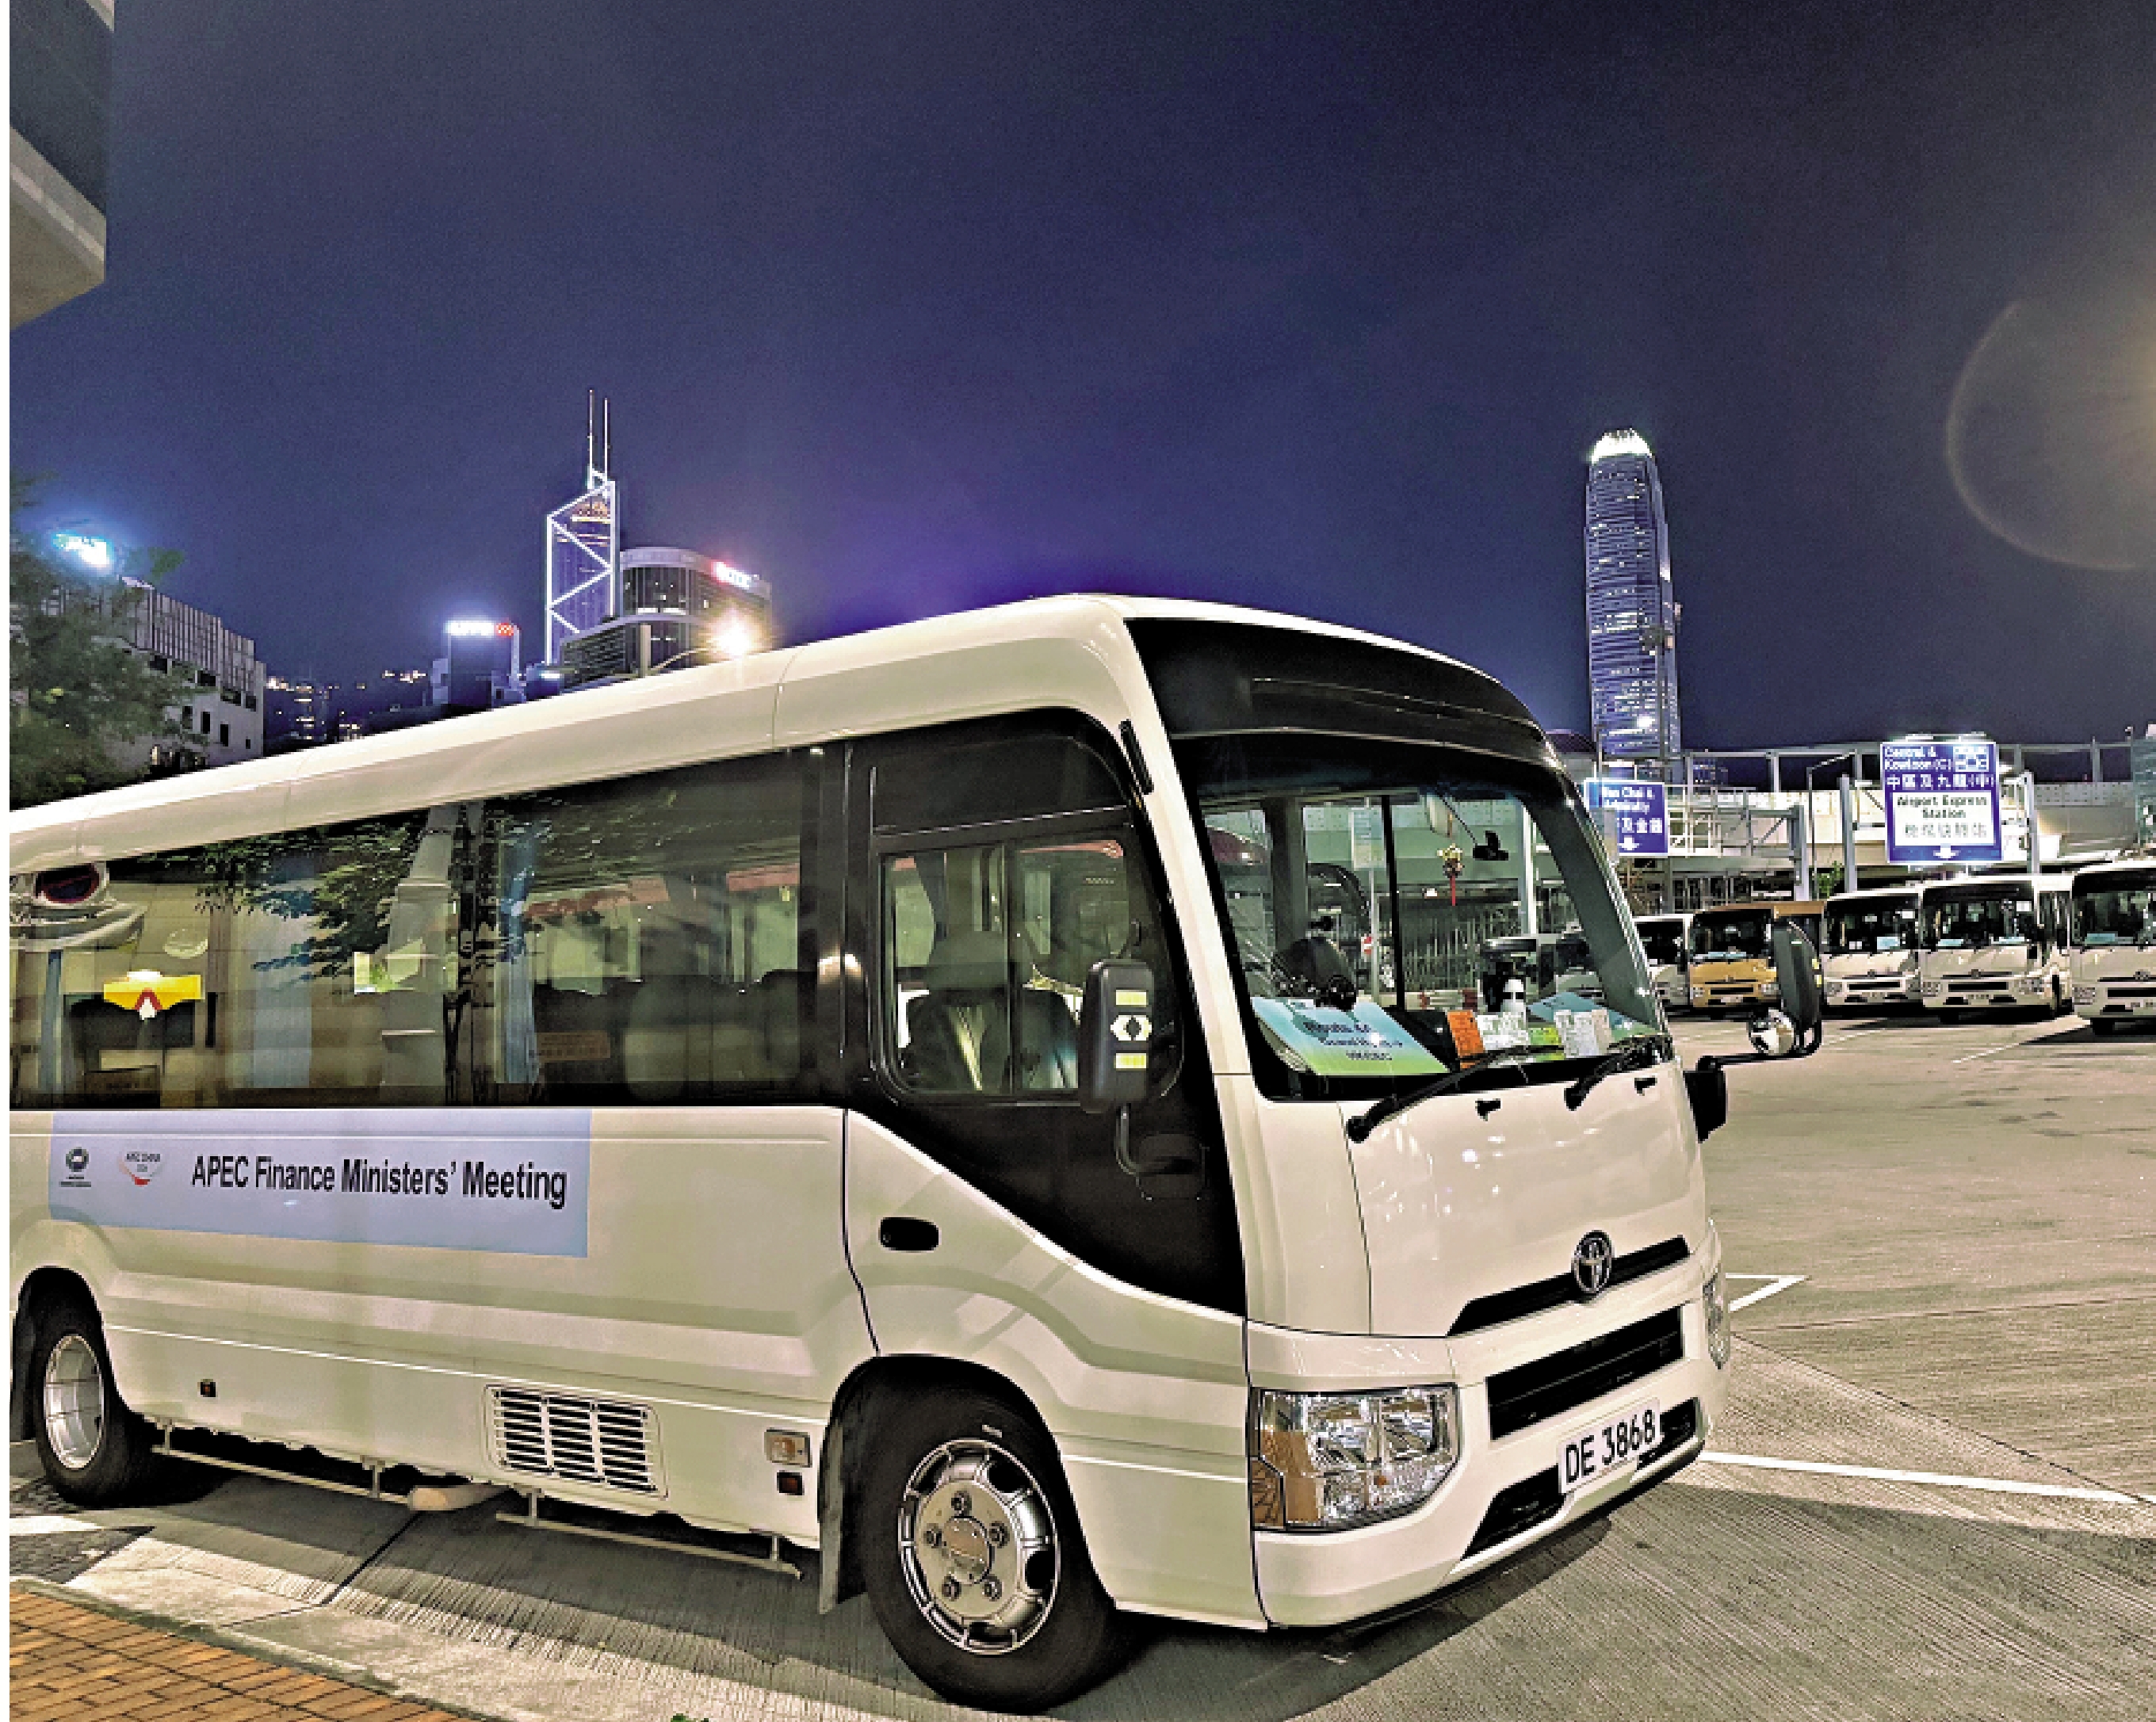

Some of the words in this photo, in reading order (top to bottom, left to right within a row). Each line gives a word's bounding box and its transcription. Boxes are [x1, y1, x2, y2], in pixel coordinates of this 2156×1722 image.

[192, 1155, 249, 1187] APEC
[255, 1155, 336, 1190] Finance
[462, 1161, 568, 1209] Meeting
[1566, 1435, 1596, 1484] DE
[1602, 1410, 1656, 1465] 3868
